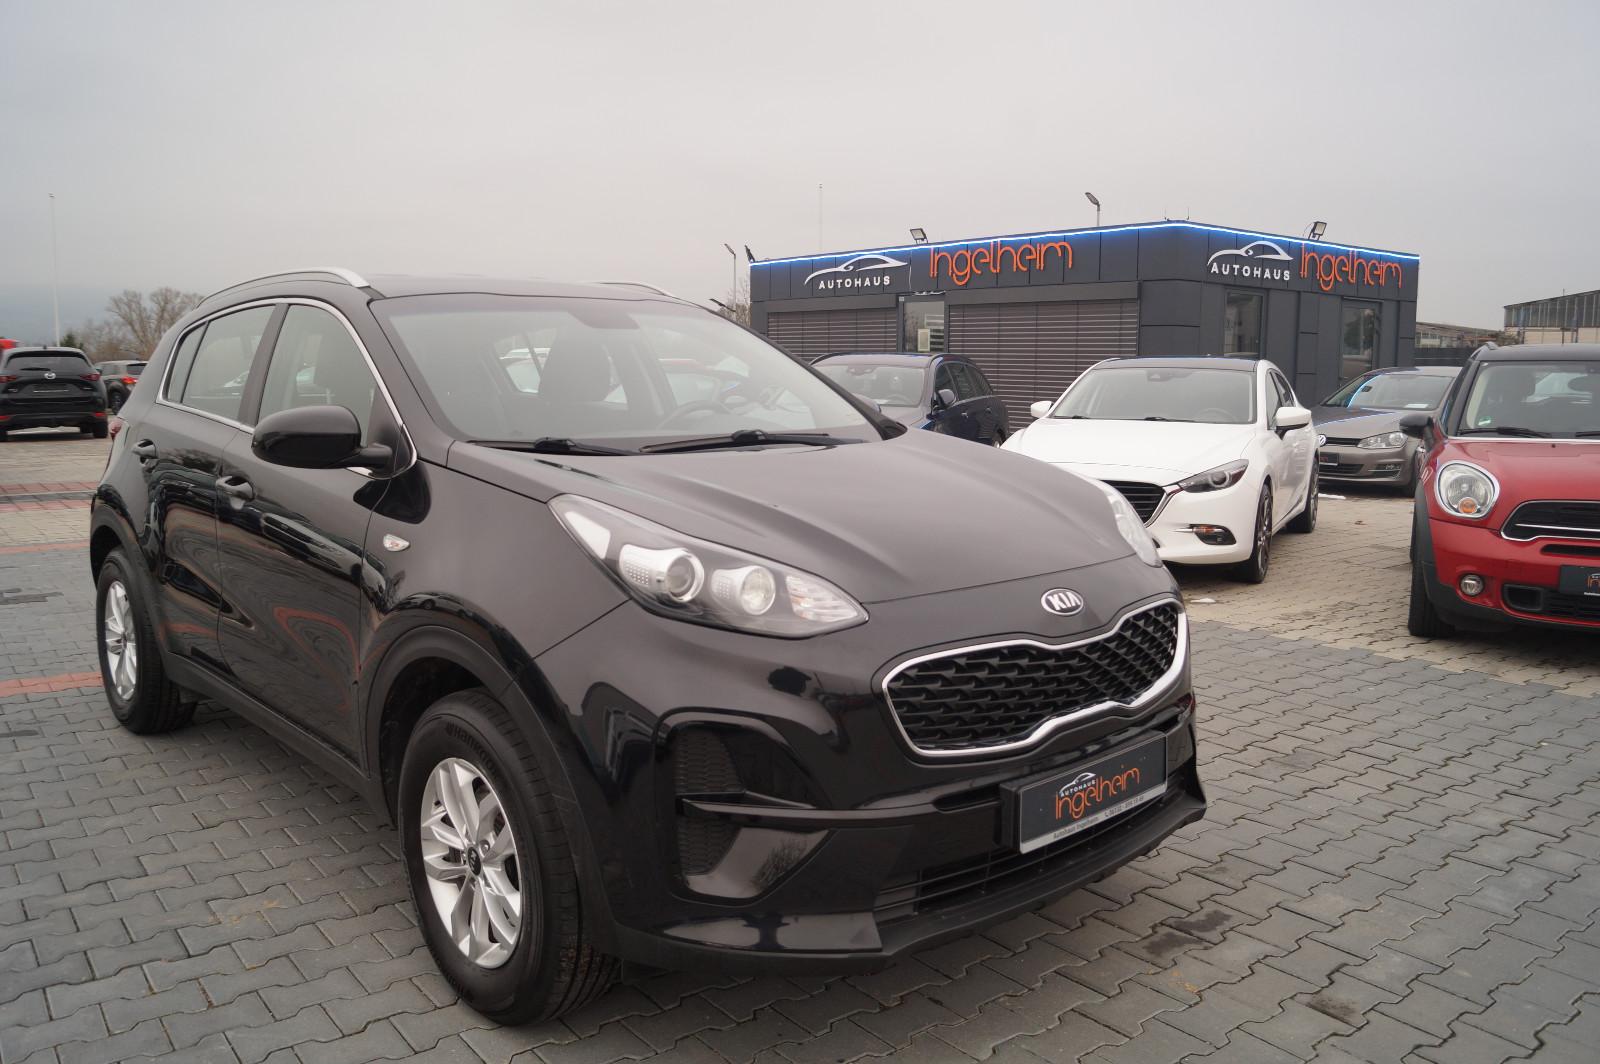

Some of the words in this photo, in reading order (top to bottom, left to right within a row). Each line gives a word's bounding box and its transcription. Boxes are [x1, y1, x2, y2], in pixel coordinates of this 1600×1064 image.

[930, 240, 1073, 286] Ingelheim
[1210, 262, 1290, 281] AUTOHAUS
[1300, 242, 1402, 291] Ingelheim
[818, 275, 891, 289] AUTOHAUS
[1047, 592, 1081, 611] KIA
[1055, 765, 1140, 820] Ingelheim
[1060, 780, 1096, 797] AUTOHAUS
